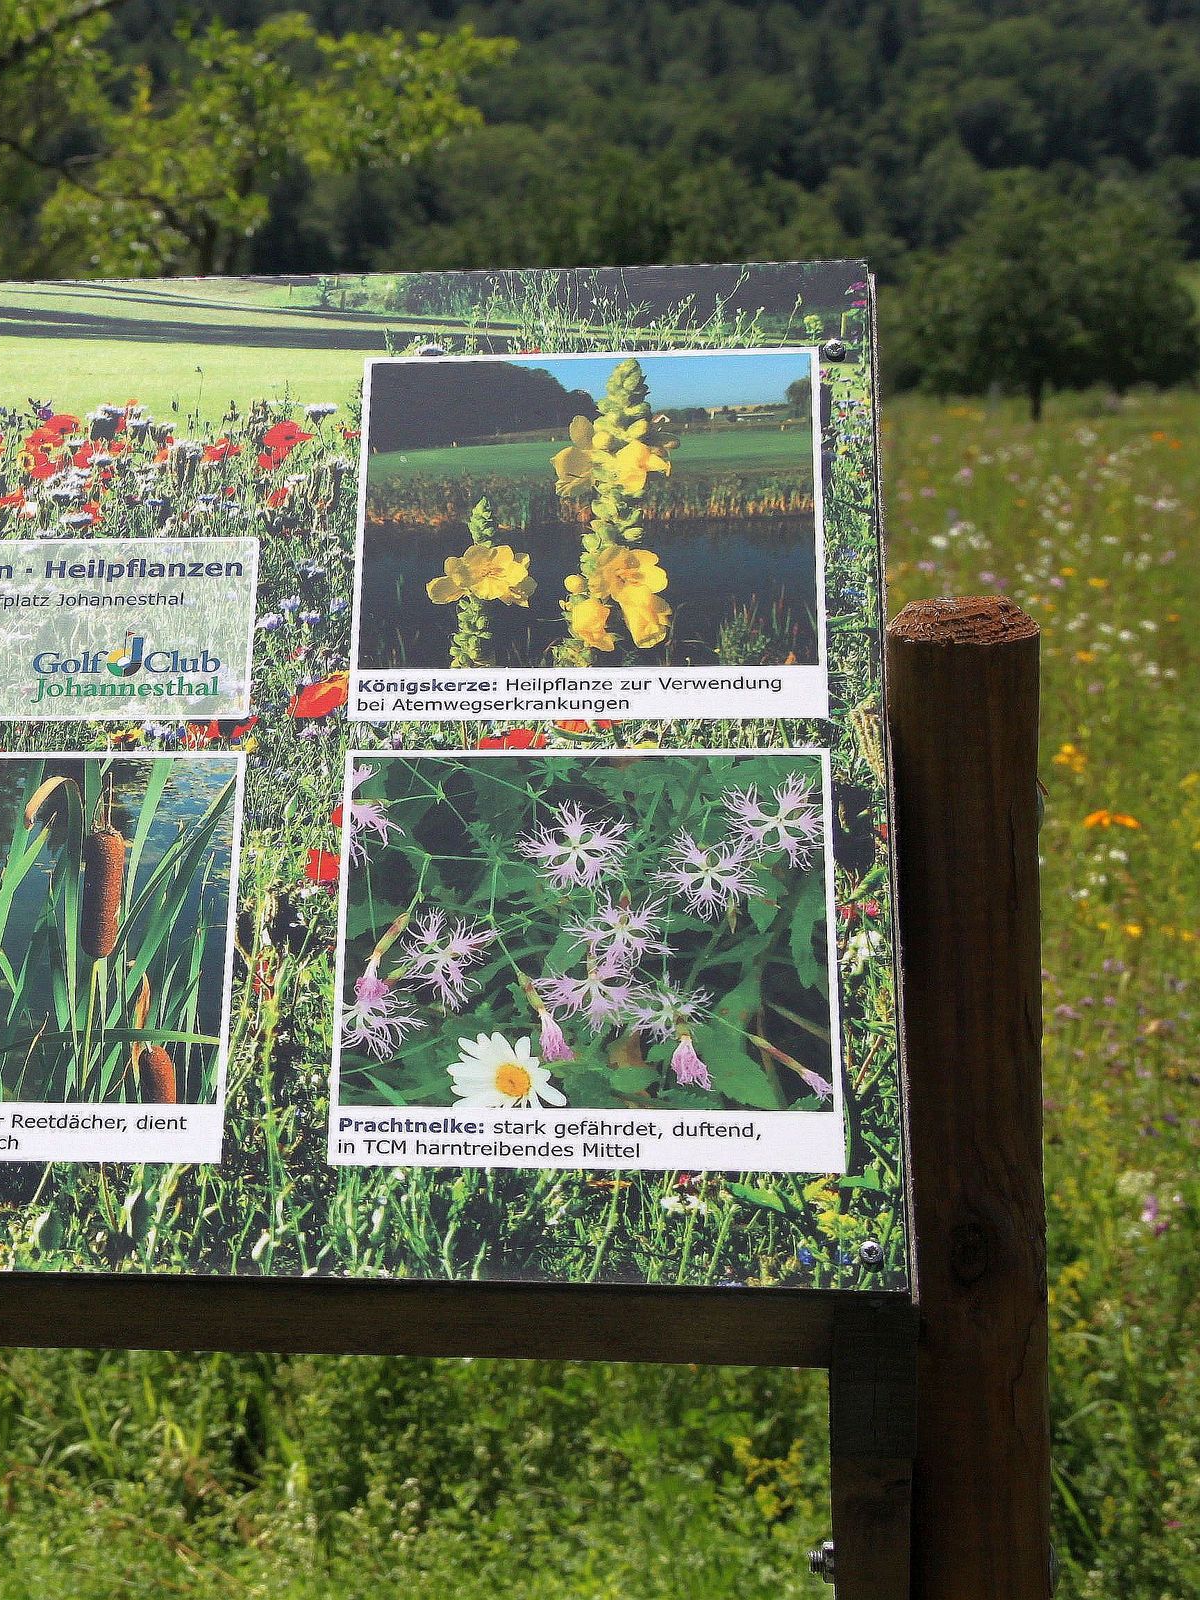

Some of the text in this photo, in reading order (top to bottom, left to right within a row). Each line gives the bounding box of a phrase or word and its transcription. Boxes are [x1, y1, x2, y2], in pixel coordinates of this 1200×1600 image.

[45, 558, 243, 582] Heilpflanzen
[57, 592, 184, 607] Johannesthal
[33, 650, 107, 674] Golf
[144, 649, 221, 673] Club
[31, 677, 219, 703] Johannesthal
[358, 676, 782, 695] Königskerze: Heilpflanze zur Verwendung
[357, 696, 630, 713] bei Atemwegserkrankungen
[12, 1113, 127, 1133] Reetdächer,
[136, 1115, 187, 1130] dient
[338, 1118, 761, 1140] Prachtnelke: stark gefährdet, duftend,
[338, 1140, 641, 1158] in TCM harntreibendes Mittel
